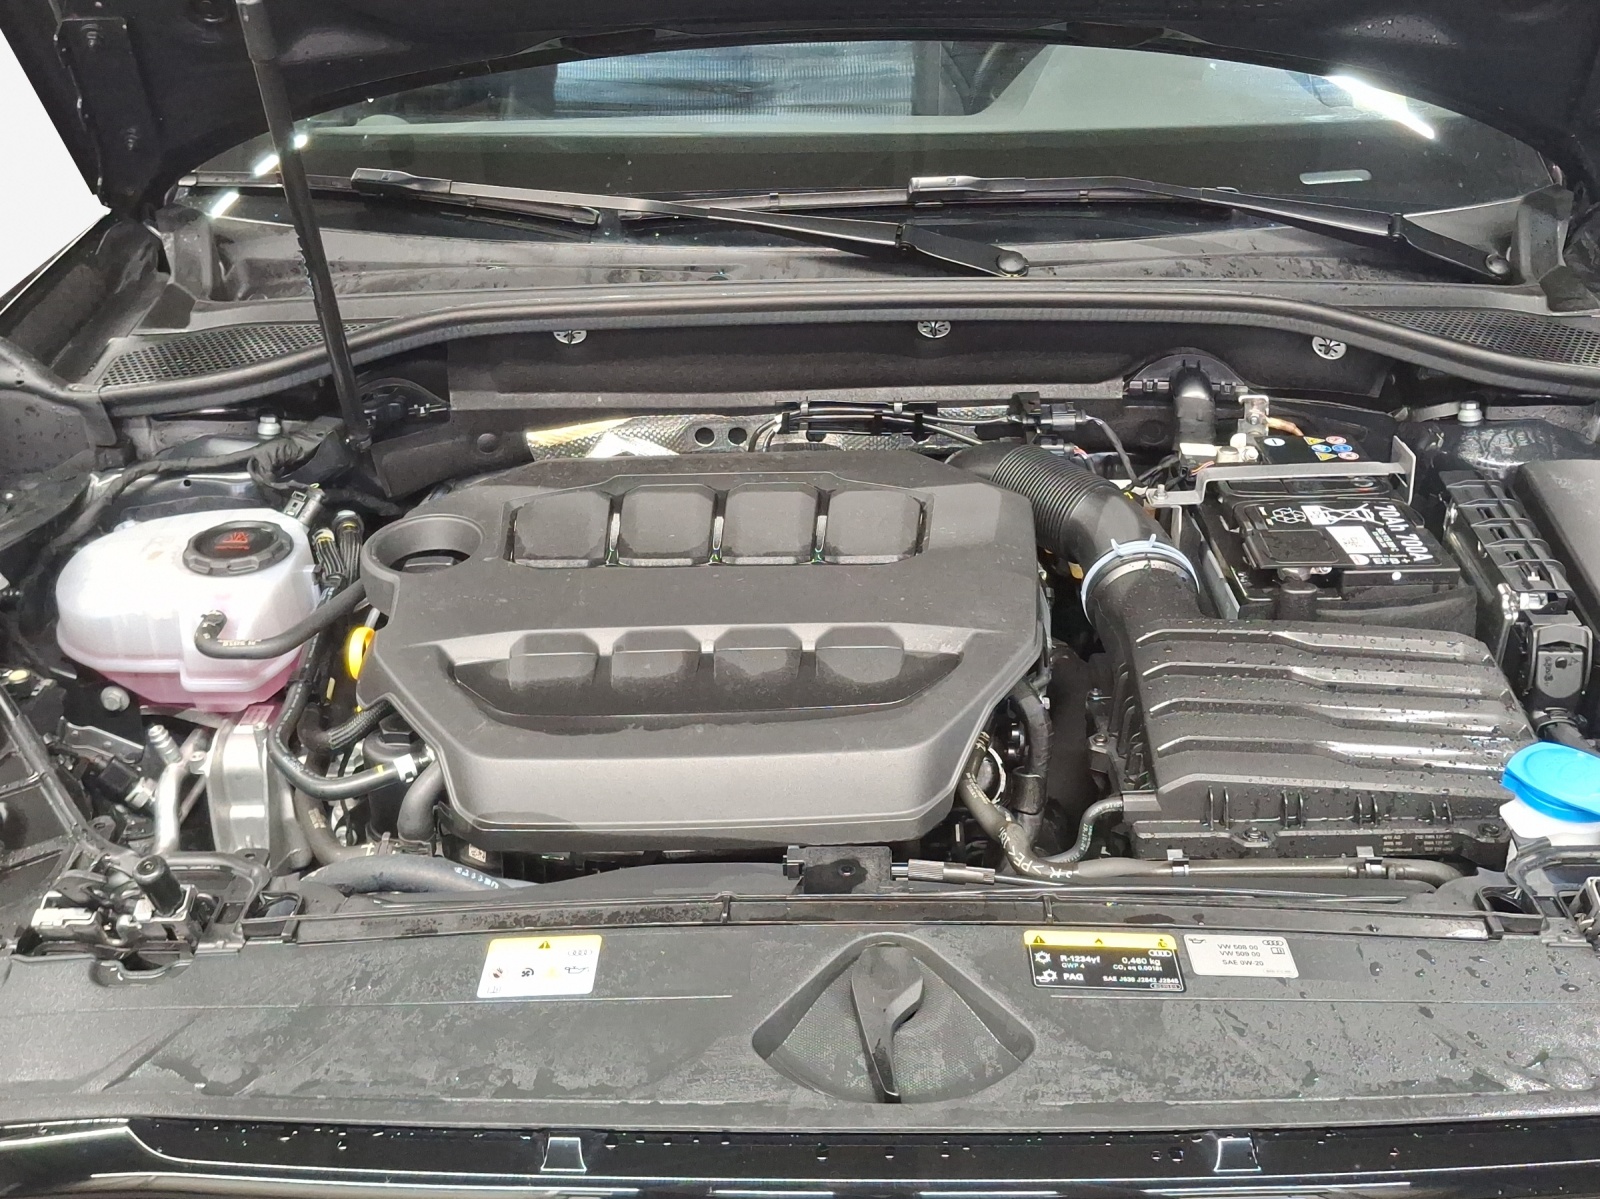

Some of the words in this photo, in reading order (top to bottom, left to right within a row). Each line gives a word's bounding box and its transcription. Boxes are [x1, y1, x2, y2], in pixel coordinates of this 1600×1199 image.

[1374, 505, 1409, 531] 70Ah
[1396, 533, 1433, 561] 700A
[1060, 955, 1101, 964] R-1234yf
[1149, 957, 1161, 966] kg
[1063, 973, 1084, 981] PAG
